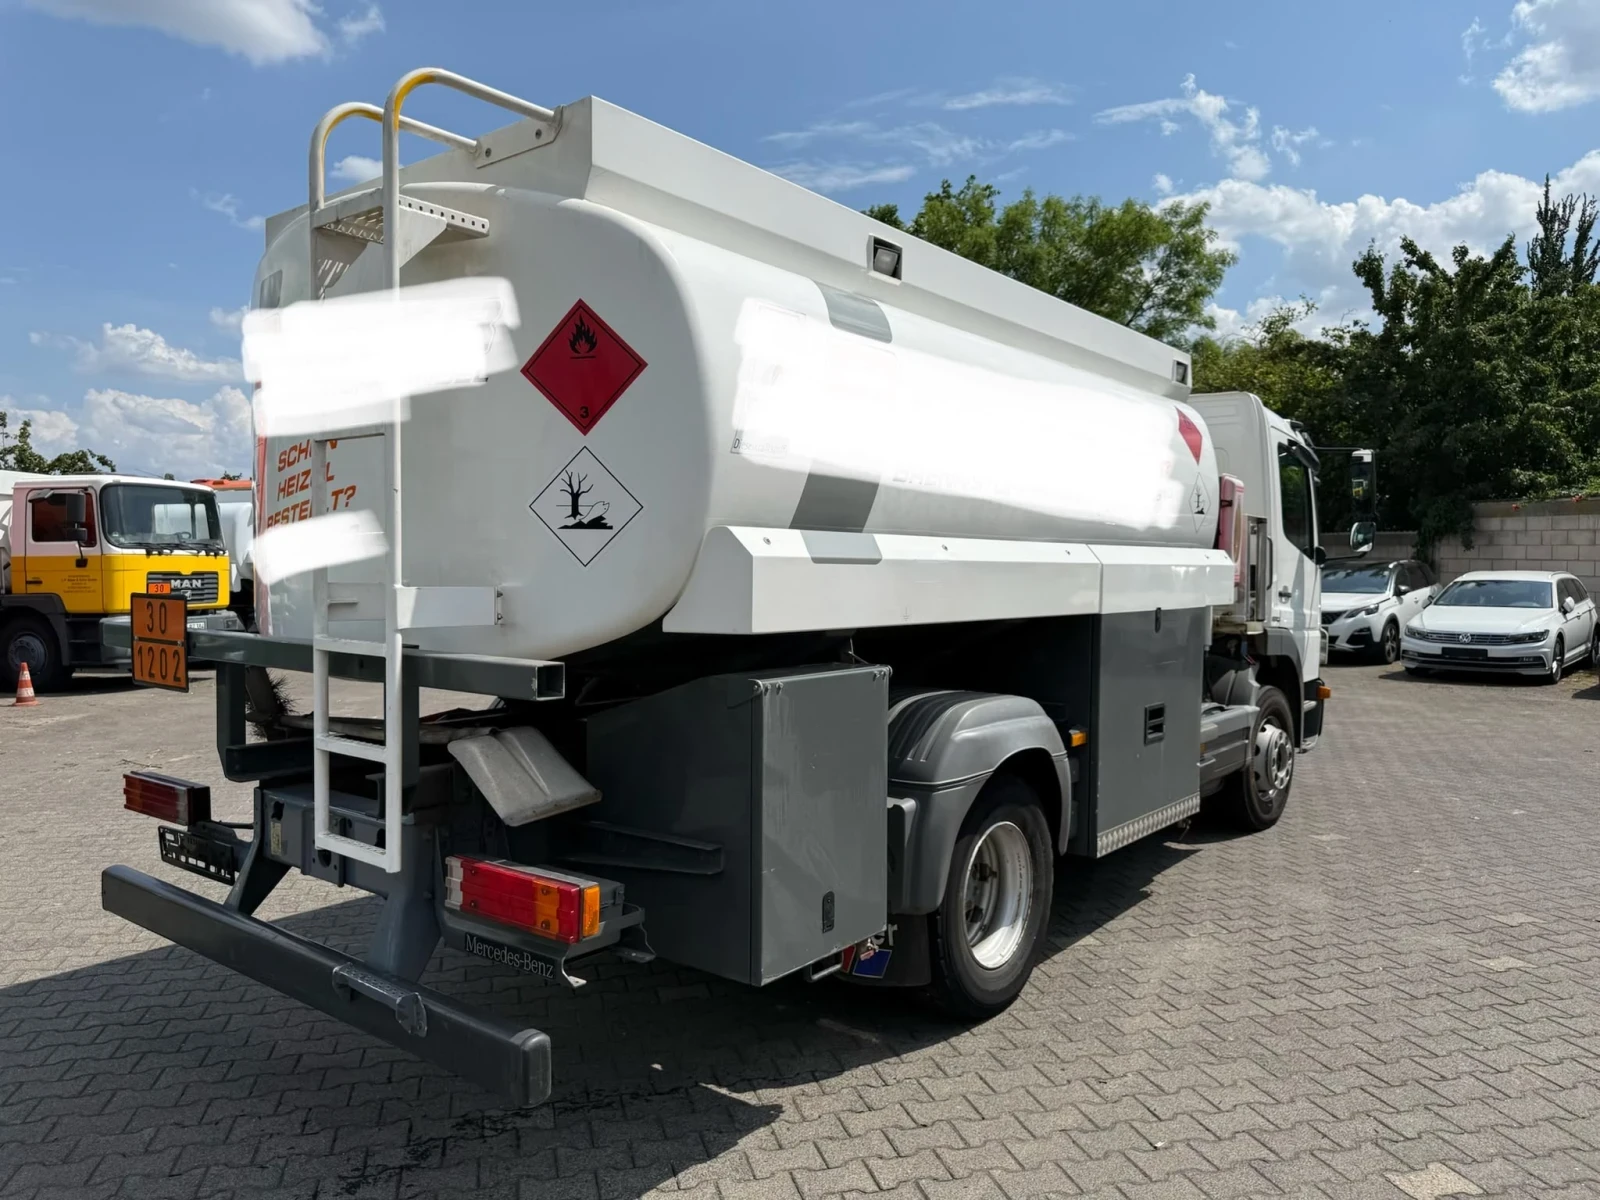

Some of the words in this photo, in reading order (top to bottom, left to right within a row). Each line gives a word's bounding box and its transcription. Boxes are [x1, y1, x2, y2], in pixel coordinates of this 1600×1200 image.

[579, 405, 590, 419] 3
[277, 462, 336, 502] HEIZL
[267, 485, 357, 529] BESTET?
[154, 584, 165, 593] 30
[170, 579, 202, 588] MAN
[146, 601, 168, 634] 30
[137, 648, 182, 683] 1202
[465, 934, 554, 979] Mercedes-Benz
